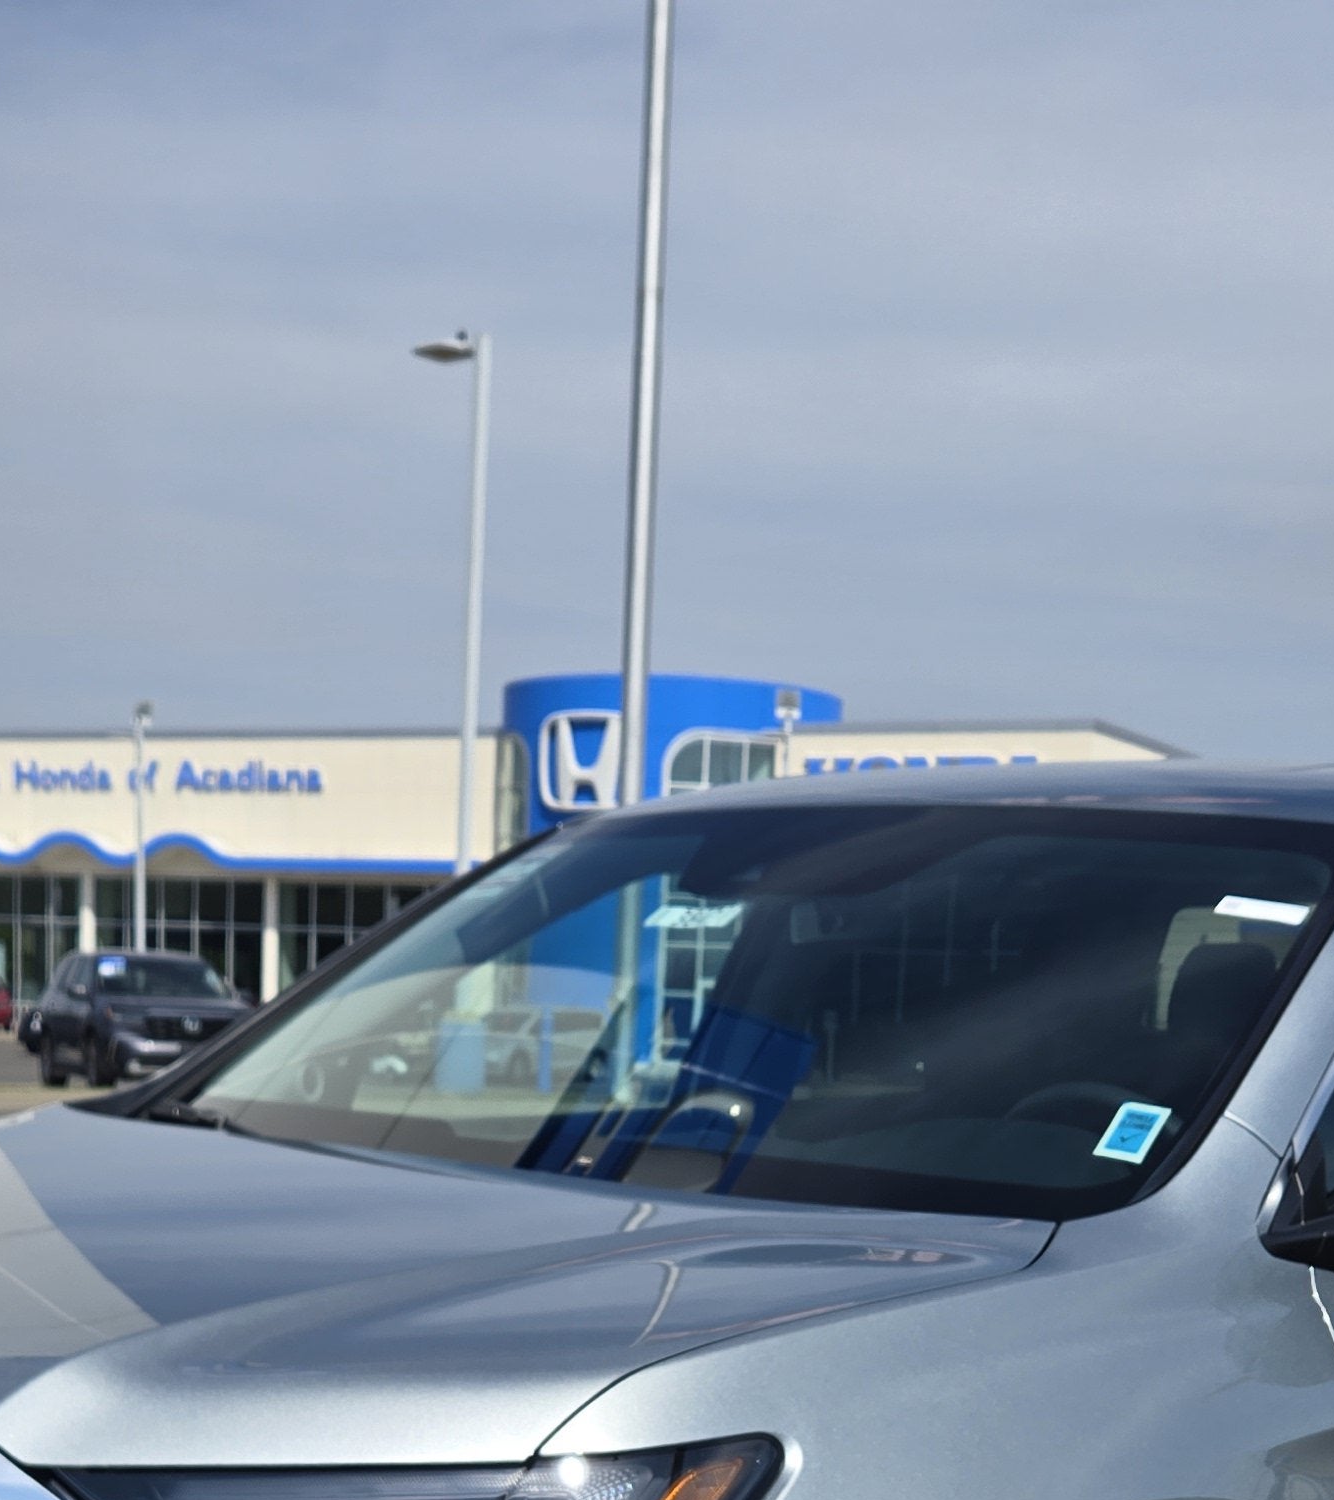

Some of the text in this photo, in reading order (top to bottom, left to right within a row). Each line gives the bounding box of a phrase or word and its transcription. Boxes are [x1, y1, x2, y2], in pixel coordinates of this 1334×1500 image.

[13, 758, 112, 792] Honda
[128, 759, 158, 793] of
[175, 759, 323, 793] Acadiana
